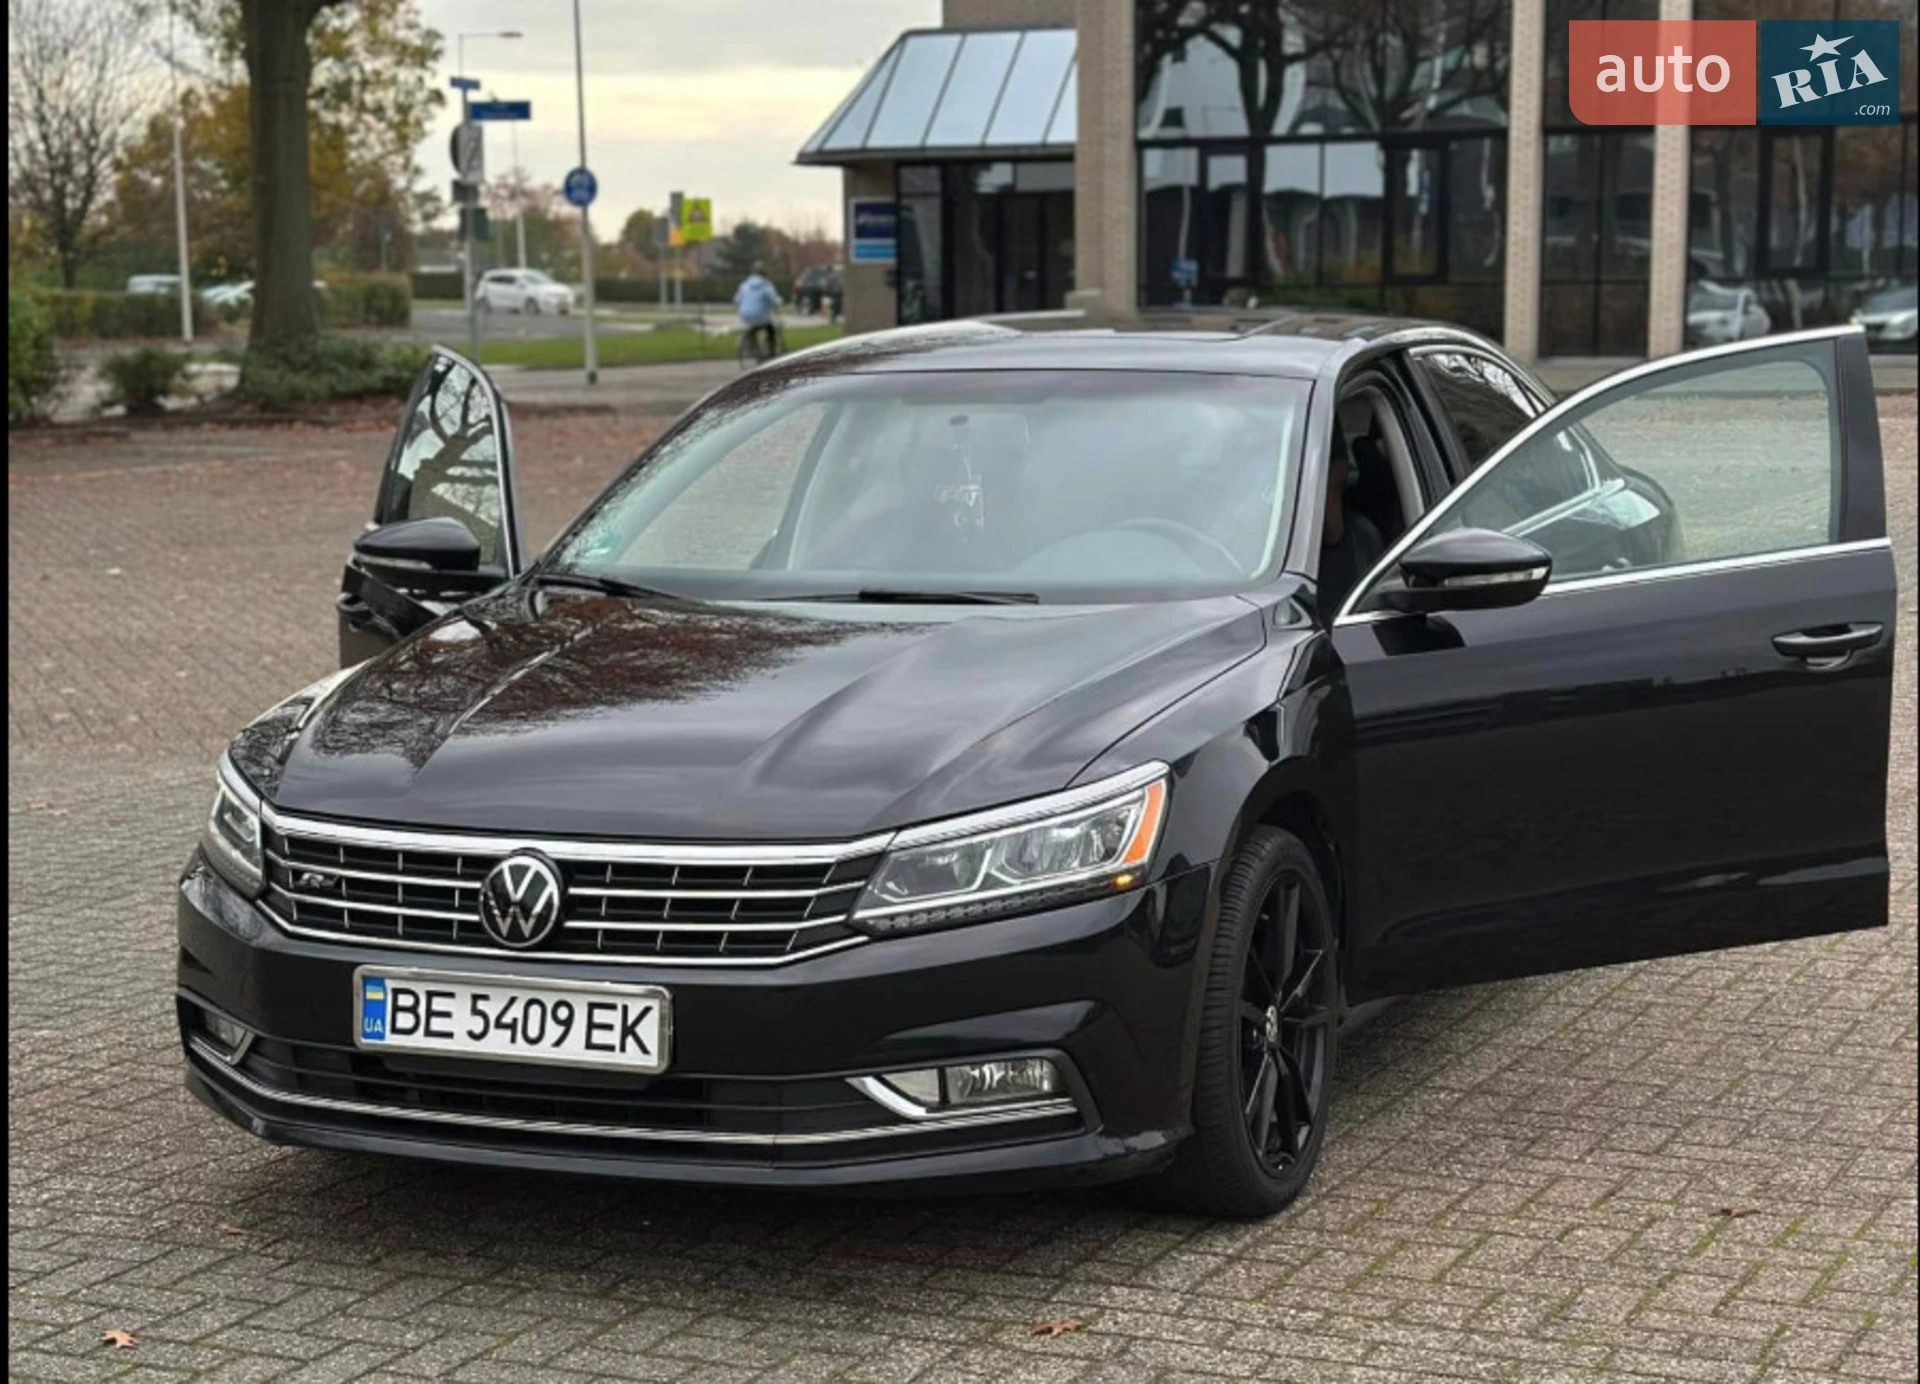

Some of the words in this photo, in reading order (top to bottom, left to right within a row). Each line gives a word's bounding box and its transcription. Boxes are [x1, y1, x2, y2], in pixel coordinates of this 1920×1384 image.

[364, 1018, 384, 1034] UA
[390, 987, 456, 1040] BE
[466, 994, 576, 1047] 5409
[584, 1001, 654, 1056] EK
